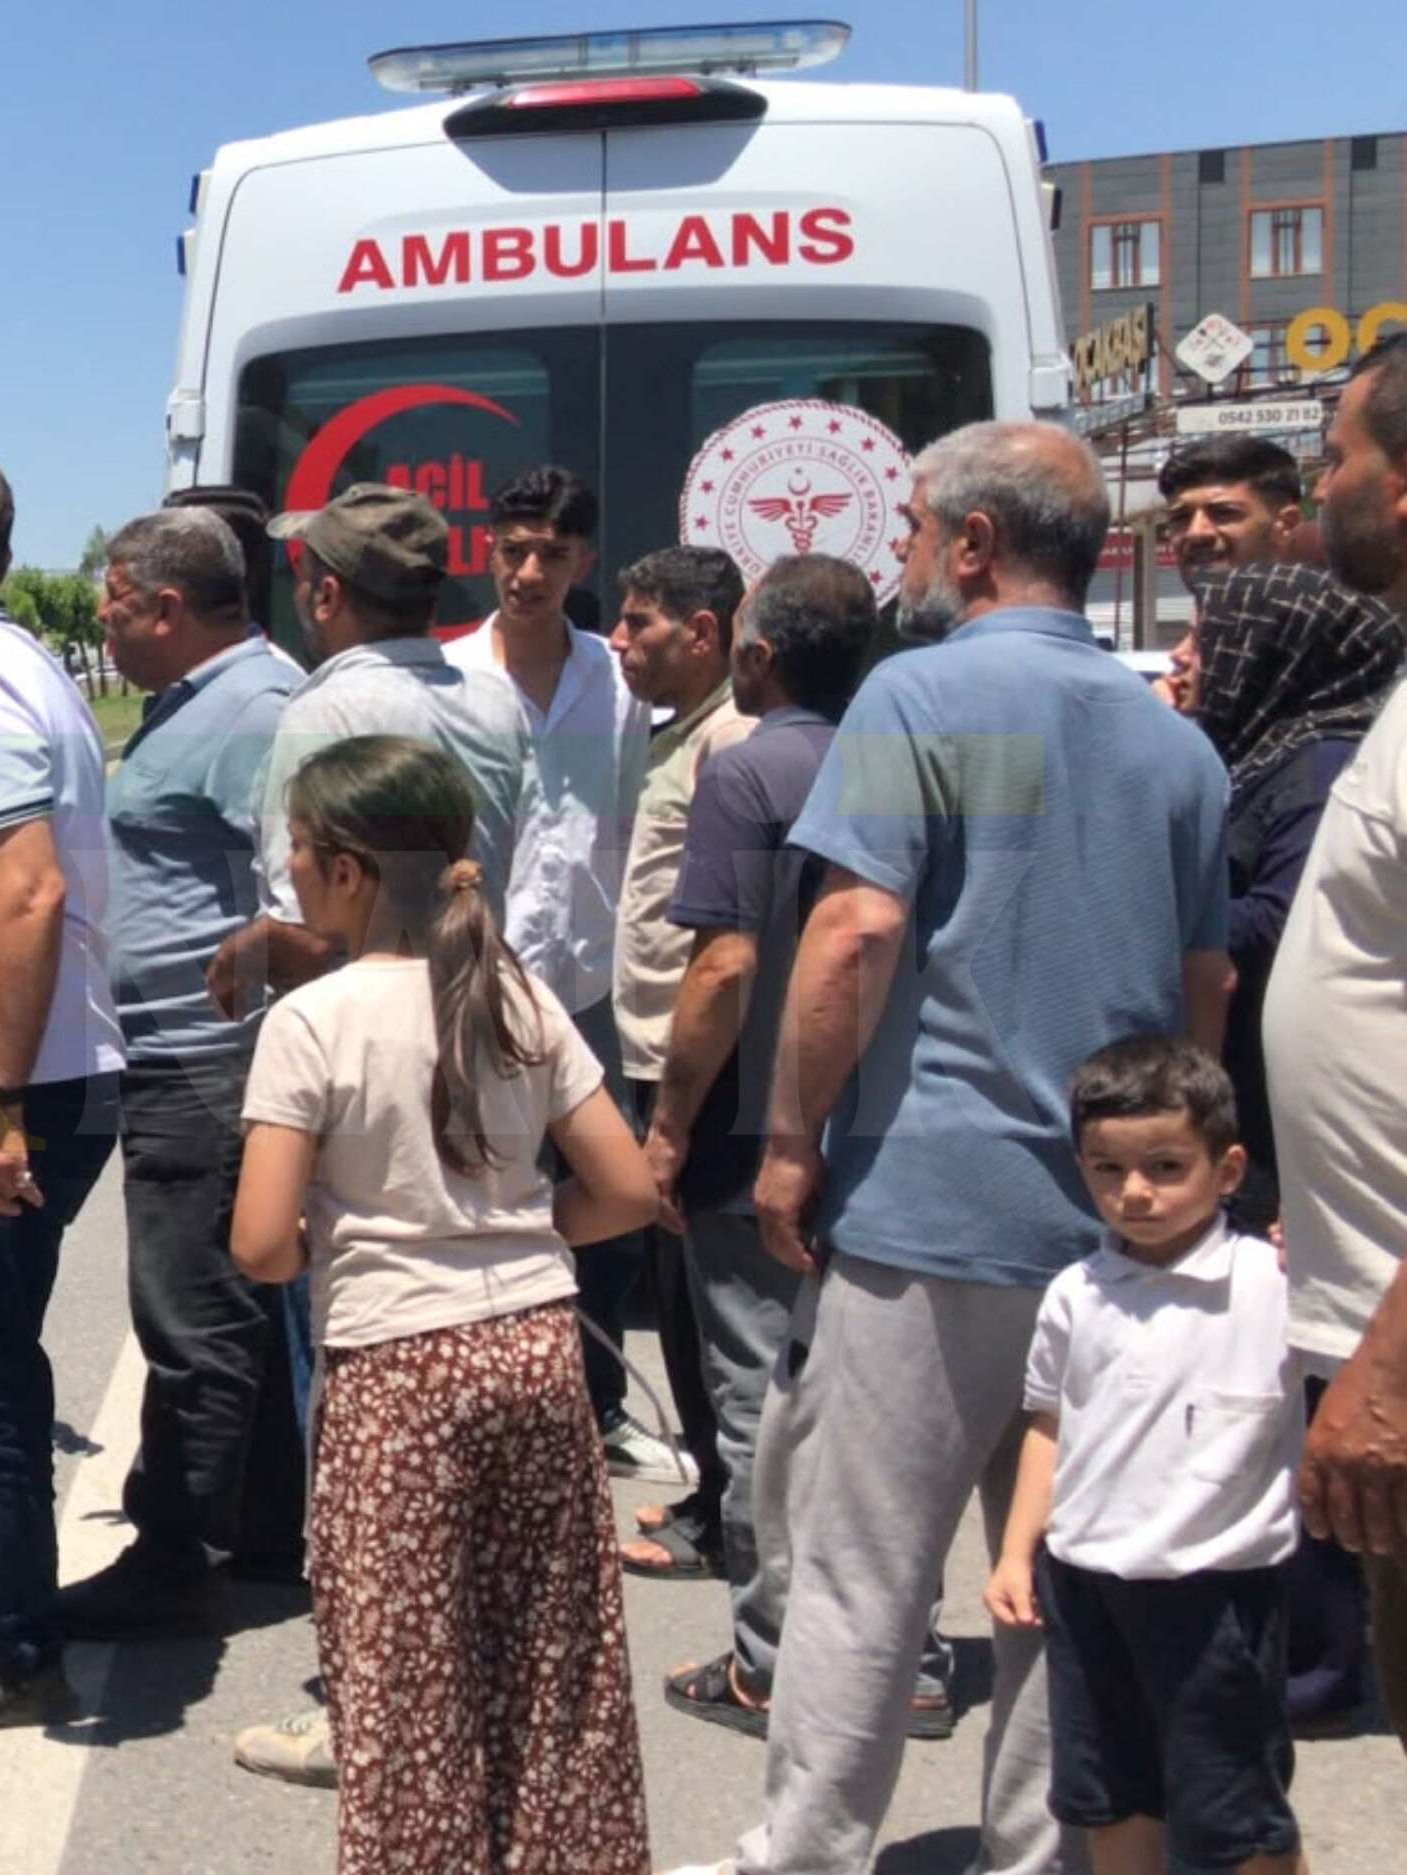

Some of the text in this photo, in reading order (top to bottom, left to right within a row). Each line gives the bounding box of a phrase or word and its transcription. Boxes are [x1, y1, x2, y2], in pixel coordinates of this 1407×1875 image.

[336, 207, 855, 293] AMBULANS
[1218, 410, 1252, 425] 0542
[1256, 408, 1283, 424] 530
